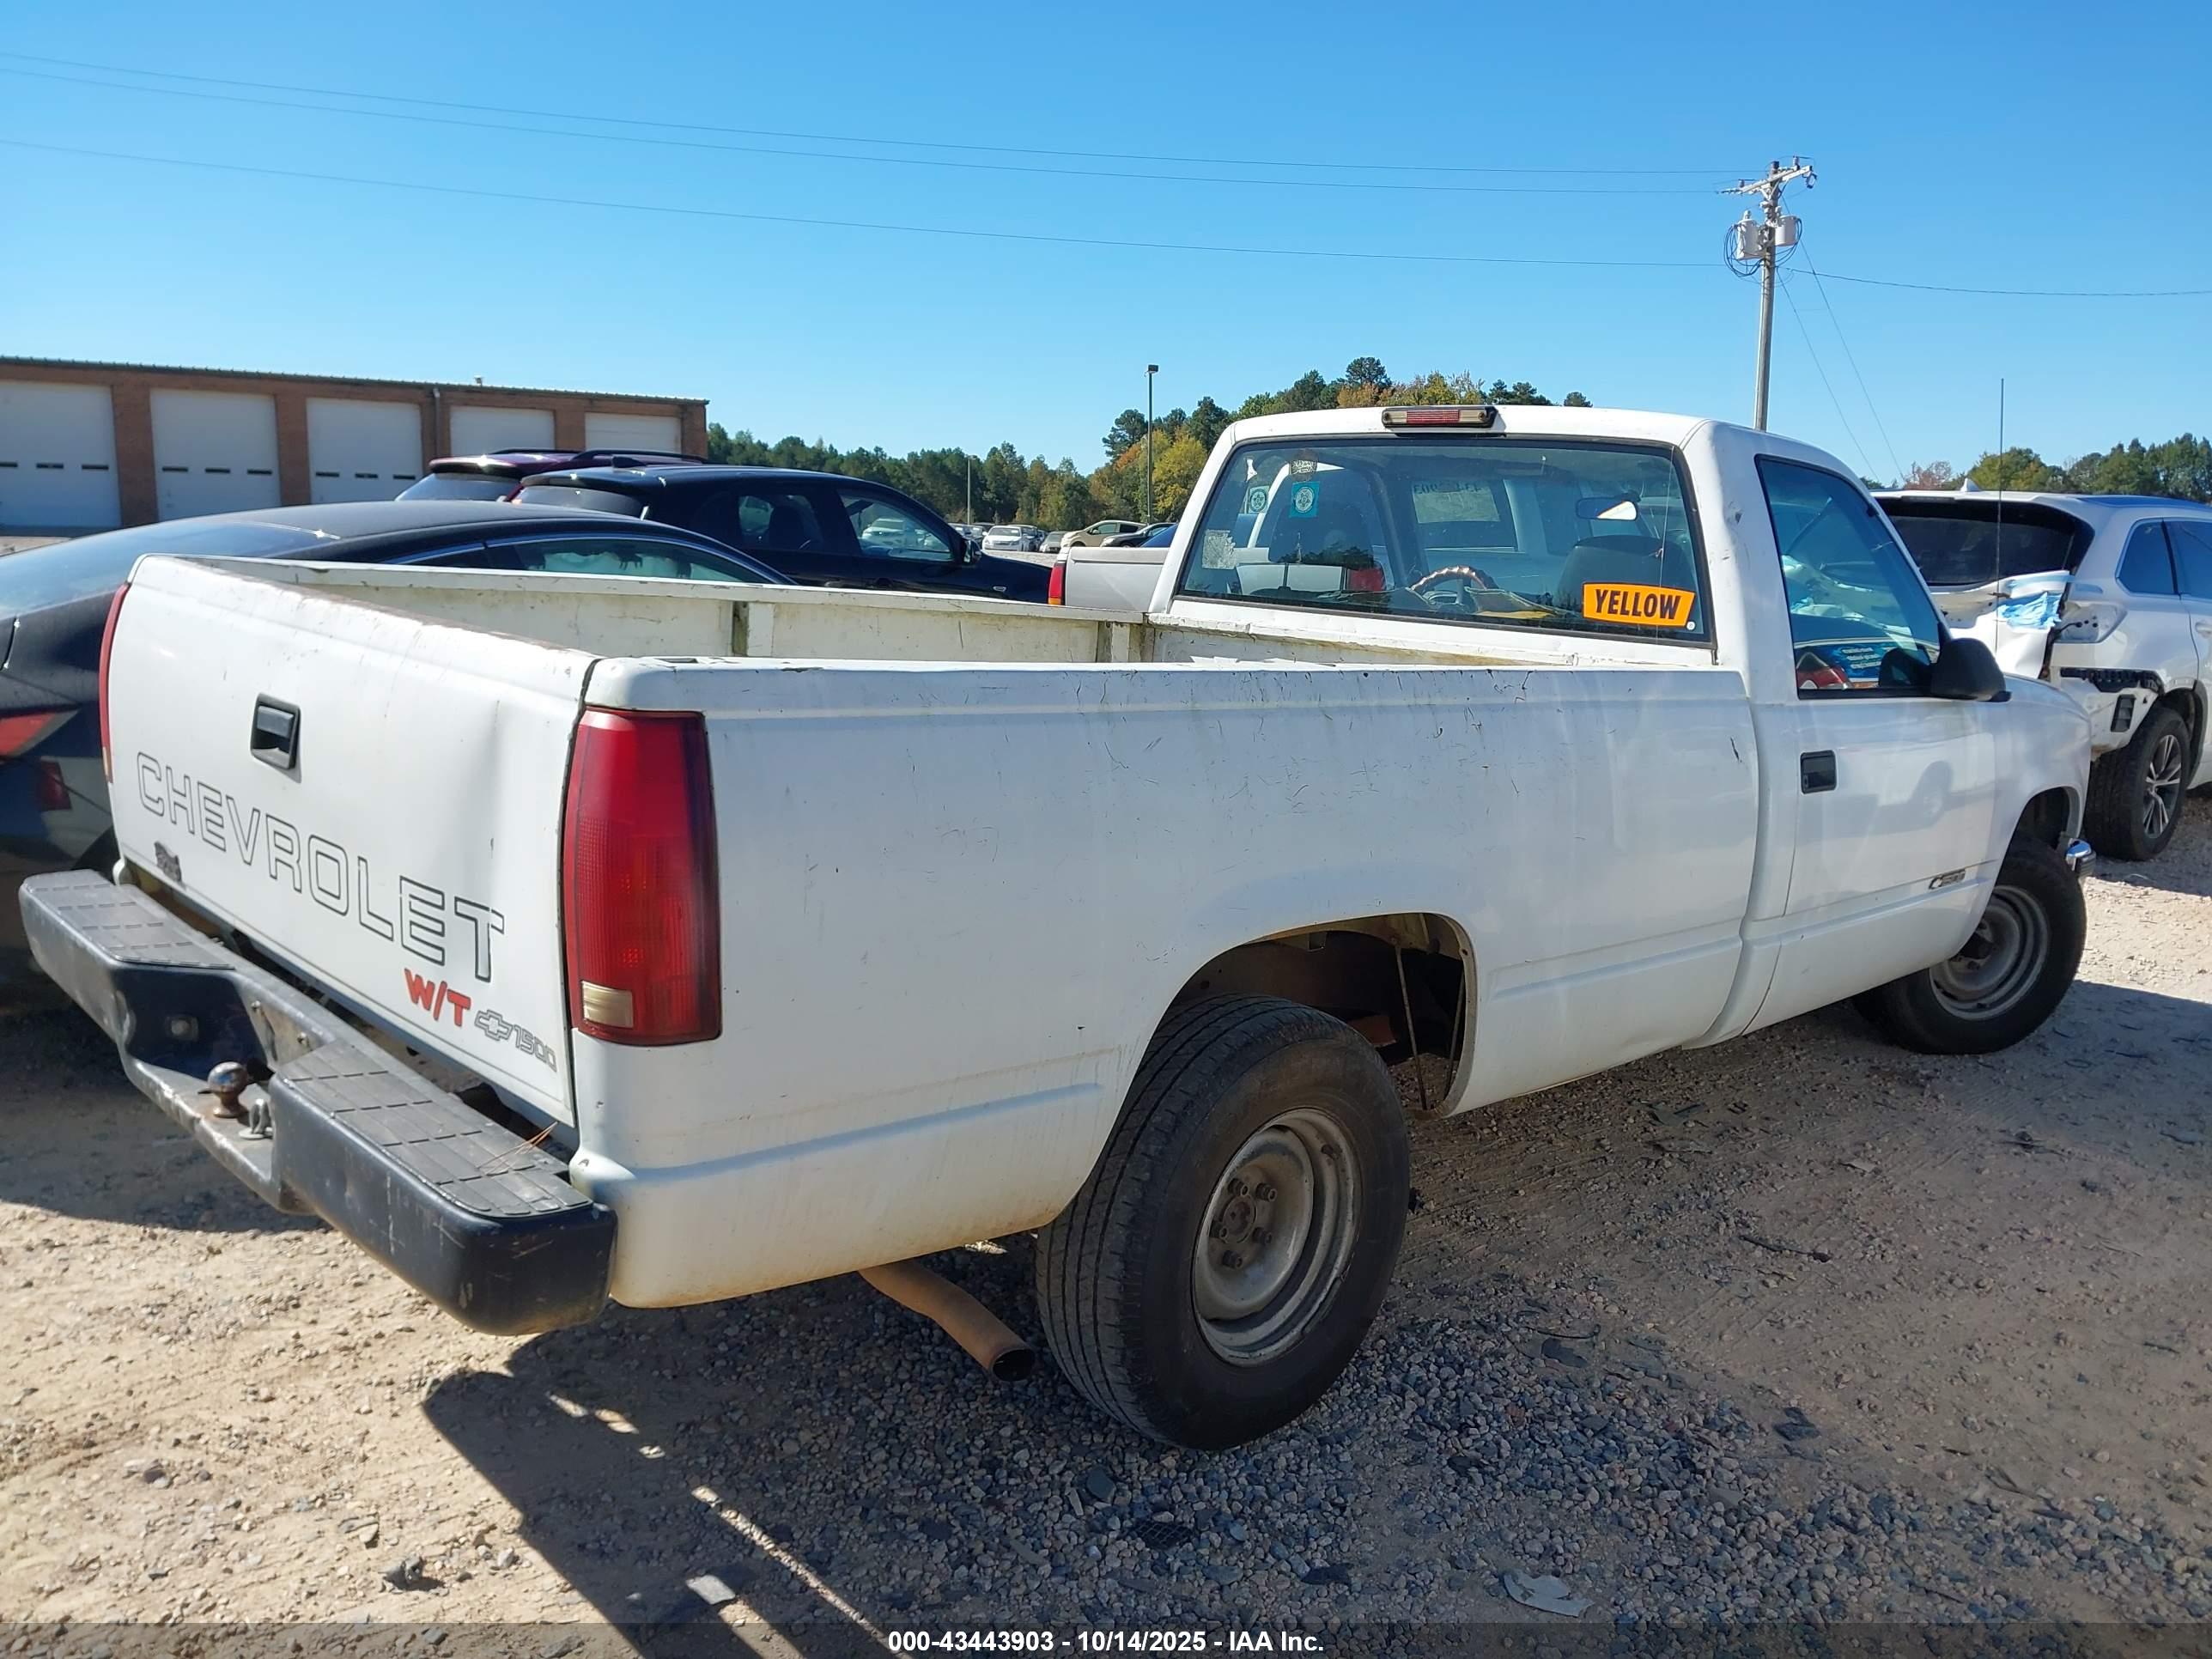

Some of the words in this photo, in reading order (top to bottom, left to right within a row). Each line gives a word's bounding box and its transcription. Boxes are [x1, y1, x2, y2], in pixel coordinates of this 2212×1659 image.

[1595, 588, 1681, 620] YELLOW
[137, 751, 505, 983] CHEVROLET
[404, 968, 472, 1028] W/T
[514, 1024, 557, 1074] 1500
